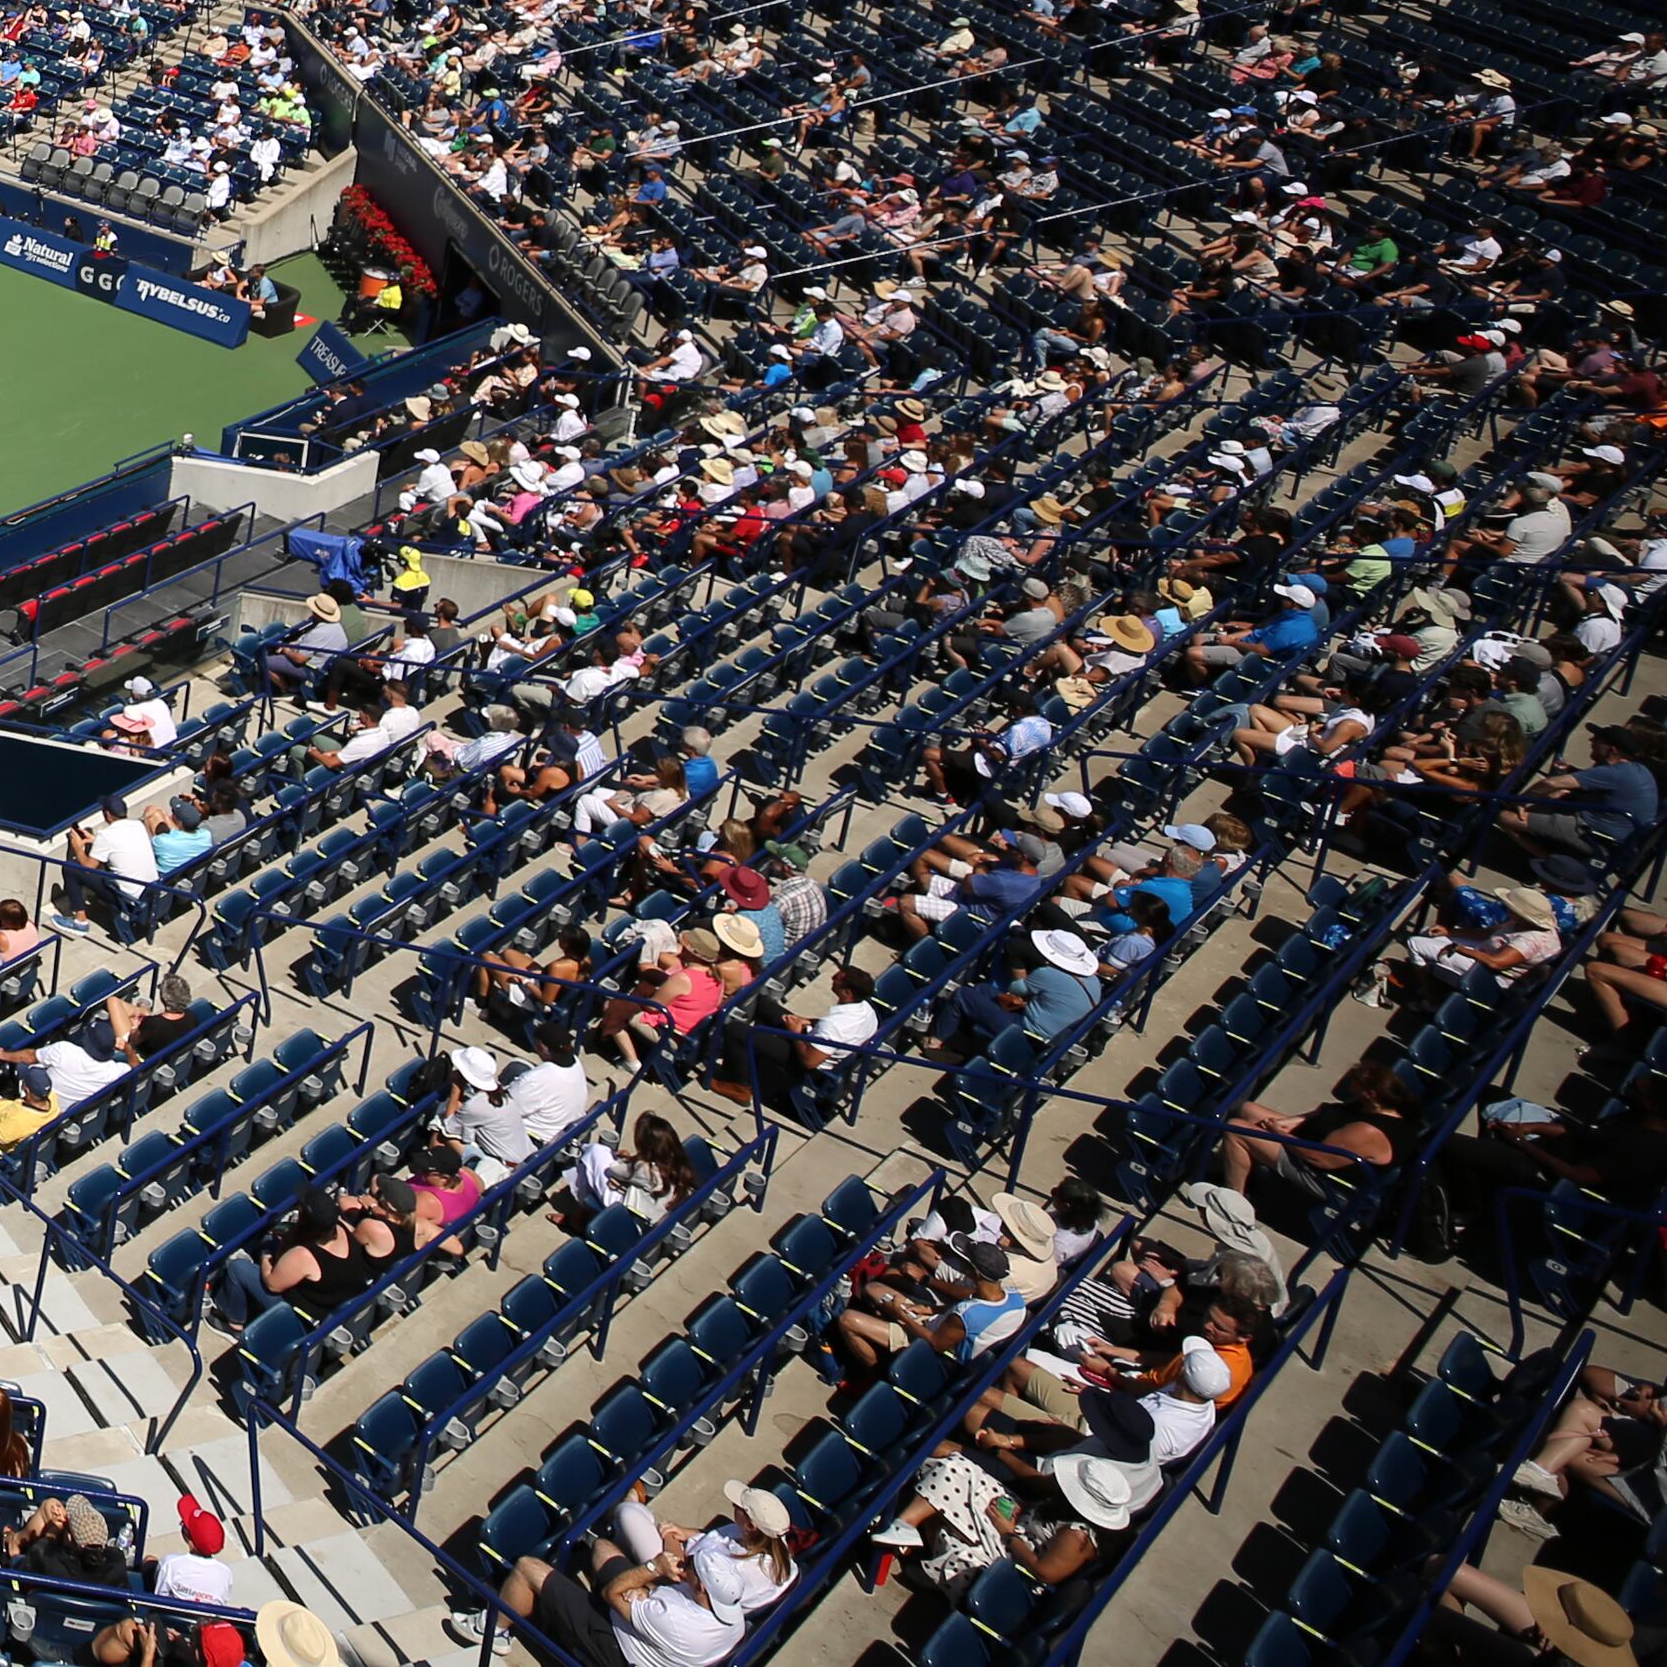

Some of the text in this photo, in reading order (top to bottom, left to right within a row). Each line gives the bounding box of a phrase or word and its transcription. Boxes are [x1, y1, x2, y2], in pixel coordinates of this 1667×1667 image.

[23, 236, 73, 266] Natural
[80, 266, 113, 291] G G
[500, 257, 543, 317] ROGERS
[310, 335, 348, 377] TREASUR
